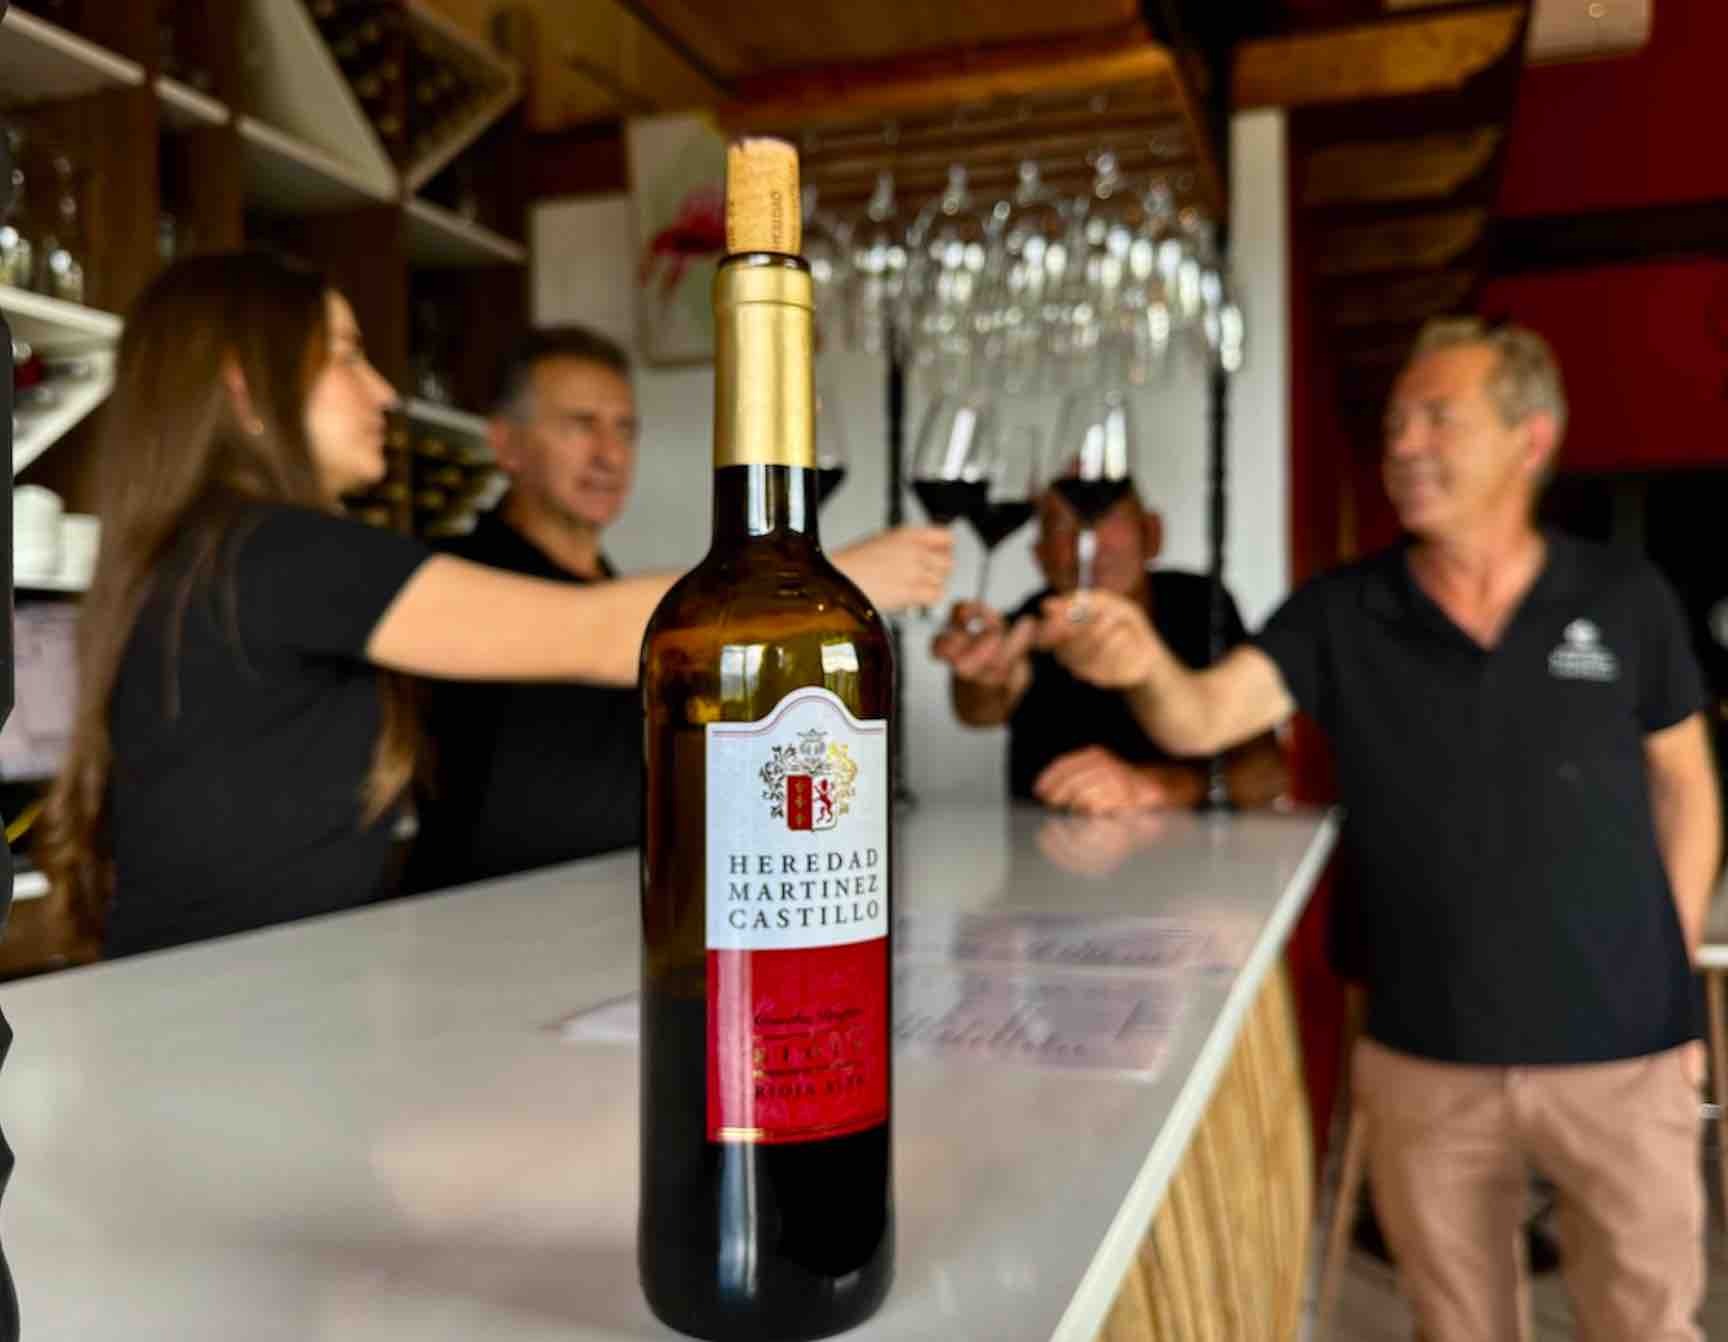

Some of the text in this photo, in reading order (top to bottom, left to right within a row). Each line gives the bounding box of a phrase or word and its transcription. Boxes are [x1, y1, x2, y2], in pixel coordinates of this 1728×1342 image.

[728, 849, 878, 875] HEREDAD
[728, 874, 879, 901] MARTINEZ
[728, 899, 879, 929] CASTILLO
